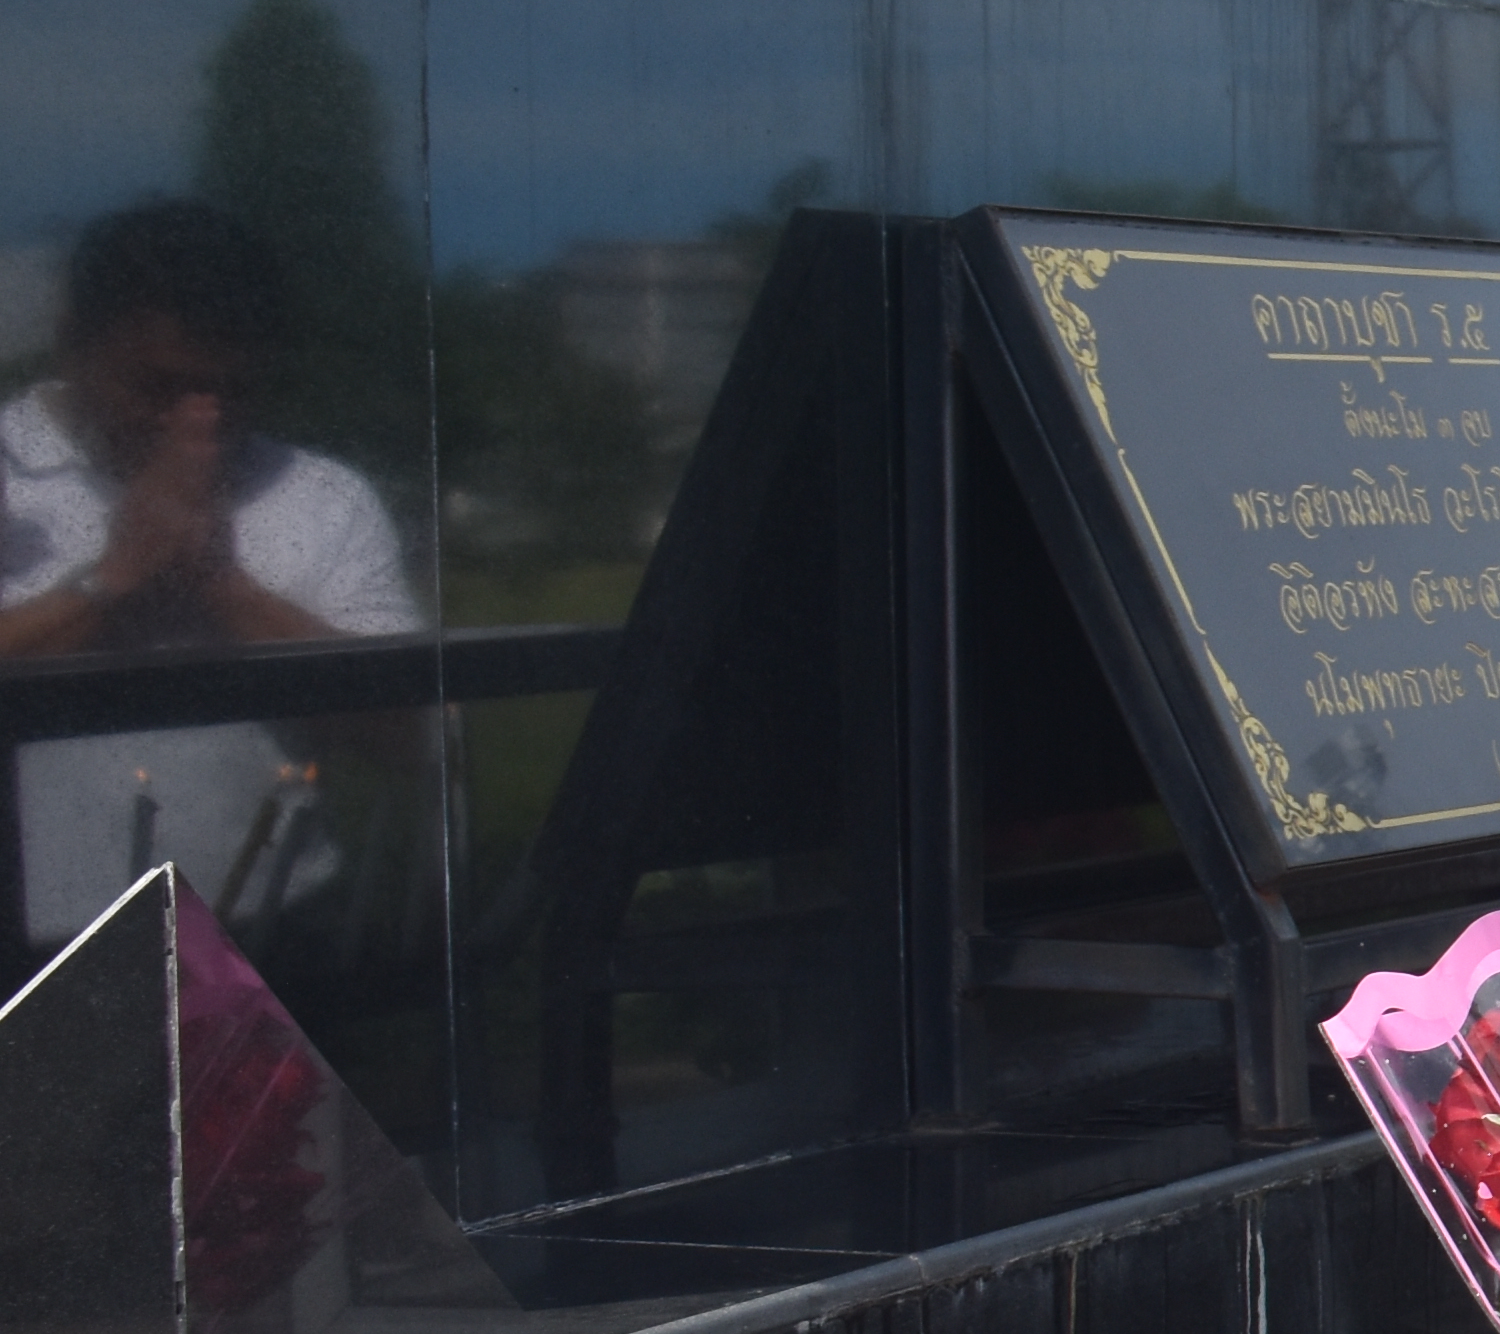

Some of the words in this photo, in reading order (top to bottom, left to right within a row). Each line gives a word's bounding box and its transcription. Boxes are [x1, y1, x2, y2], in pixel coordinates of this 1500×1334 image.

[1252, 290, 1418, 383] คาถาบูชา
[1429, 303, 1491, 350] ร.๕
[1340, 381, 1428, 439] ตั้งนะโม
[1461, 409, 1494, 447] จบ
[1233, 464, 1432, 539] พระสยามมินโธ
[1269, 556, 1399, 633] อิติอรหัง
[1305, 651, 1466, 739] นโมพุทธายะ
